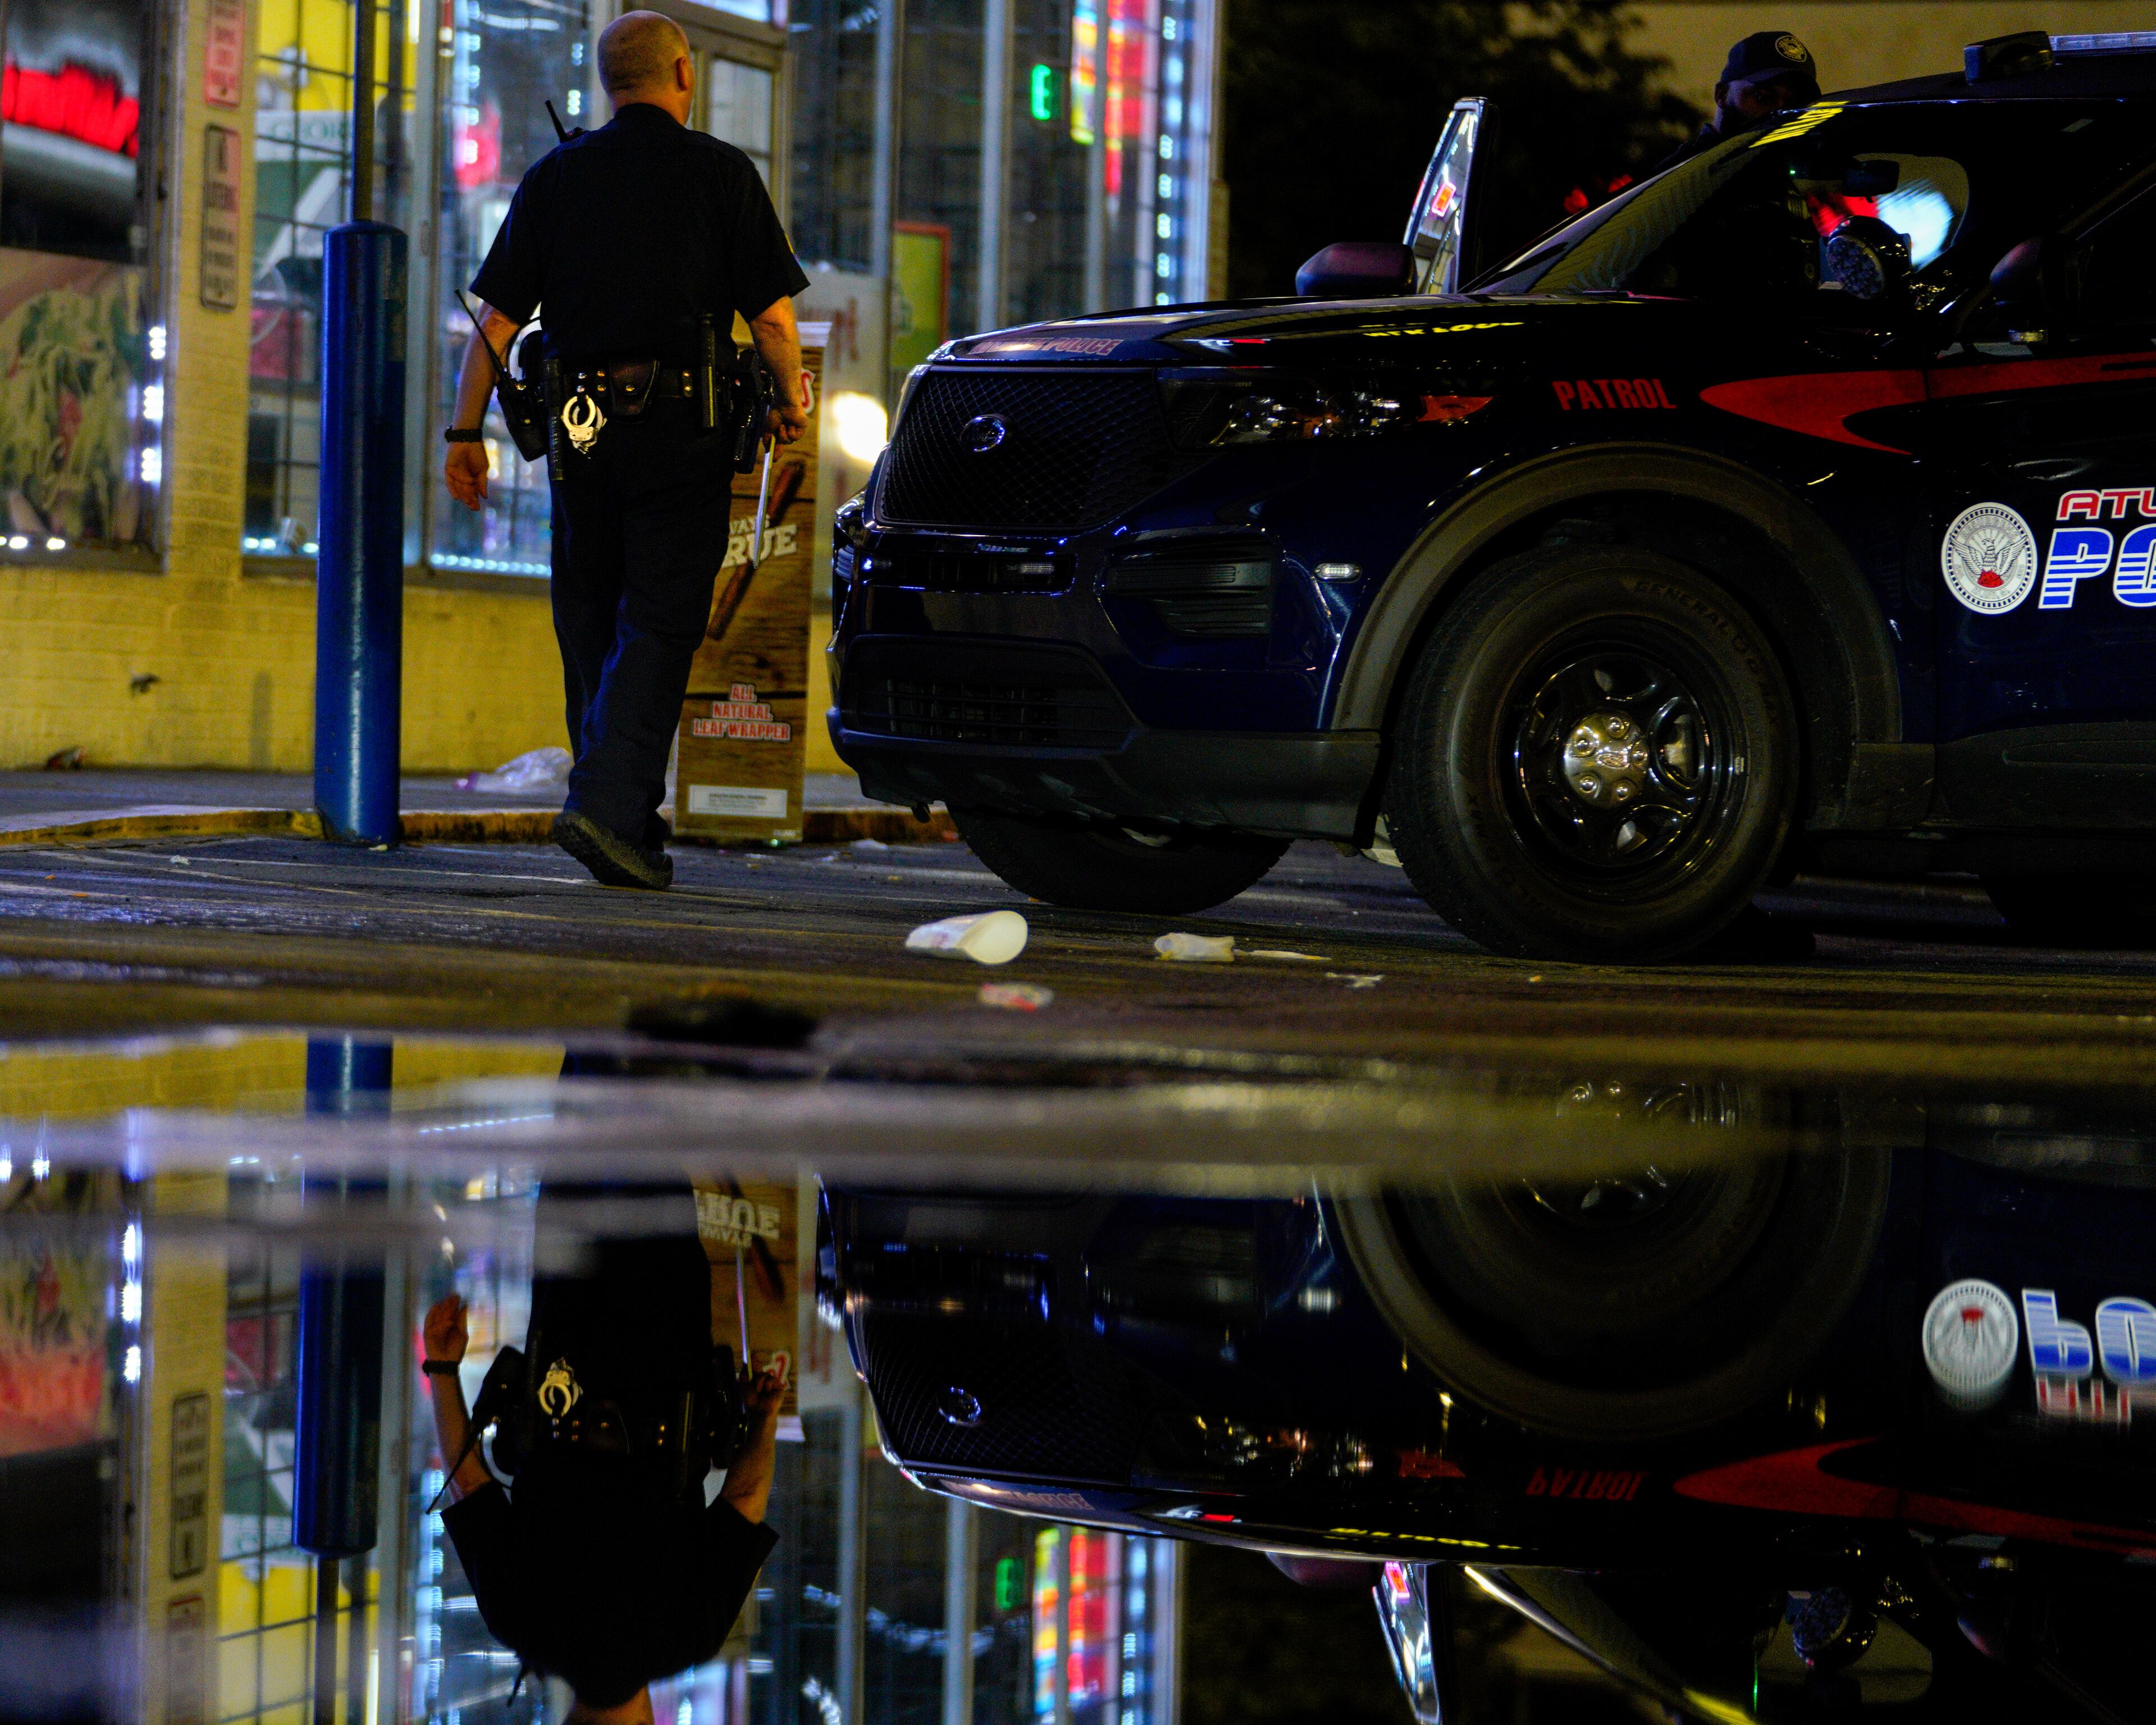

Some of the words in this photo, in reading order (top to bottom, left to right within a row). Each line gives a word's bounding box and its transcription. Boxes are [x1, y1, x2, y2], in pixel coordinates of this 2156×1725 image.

[1042, 337, 1125, 355] POLICE
[1552, 378, 1678, 411] PATROL
[731, 684, 756, 702] ALL
[712, 702, 773, 720] NATURAL
[693, 719, 724, 736] LEAF
[727, 722, 791, 741] WRAPPER
